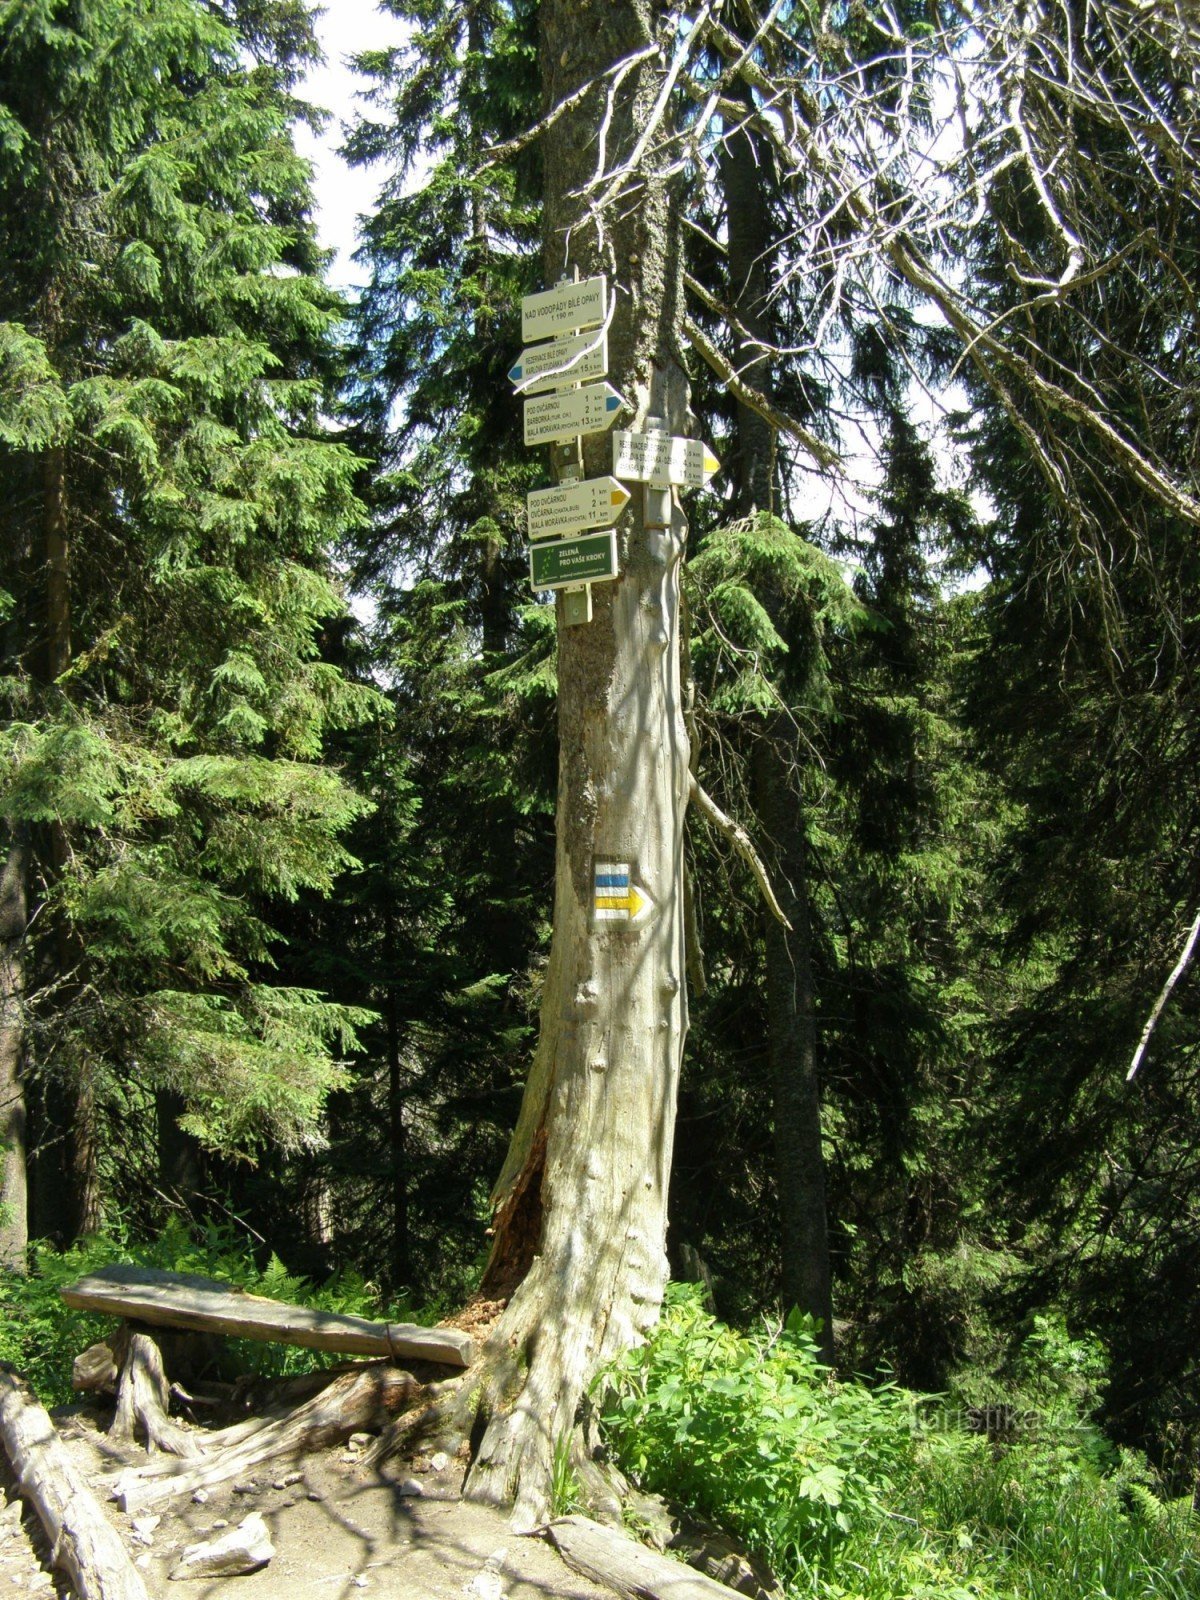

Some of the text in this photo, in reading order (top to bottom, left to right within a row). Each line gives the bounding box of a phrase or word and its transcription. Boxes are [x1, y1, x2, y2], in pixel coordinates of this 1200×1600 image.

[525, 292, 600, 320] NAD VODOPÁDY BÍLÉ OPAVY
[526, 401, 560, 415] POD OVČÁRNOU
[585, 406, 590, 414] 2
[527, 414, 550, 426] BARBORKA
[527, 427, 539, 437] MALÁ
[539, 423, 560, 434] MORÁVKA
[592, 488, 596, 496] 1
[530, 493, 567, 508] POD OVČÁRNOU
[592, 500, 597, 508] 2
[530, 507, 553, 519] OVČÁRNA
[588, 511, 596, 519] 11
[531, 519, 544, 530] MALÁ
[545, 515, 568, 527] MORÁVKA
[558, 546, 579, 558] ZELENÁ
[559, 551, 605, 567] PRO VAŠE KROKY
